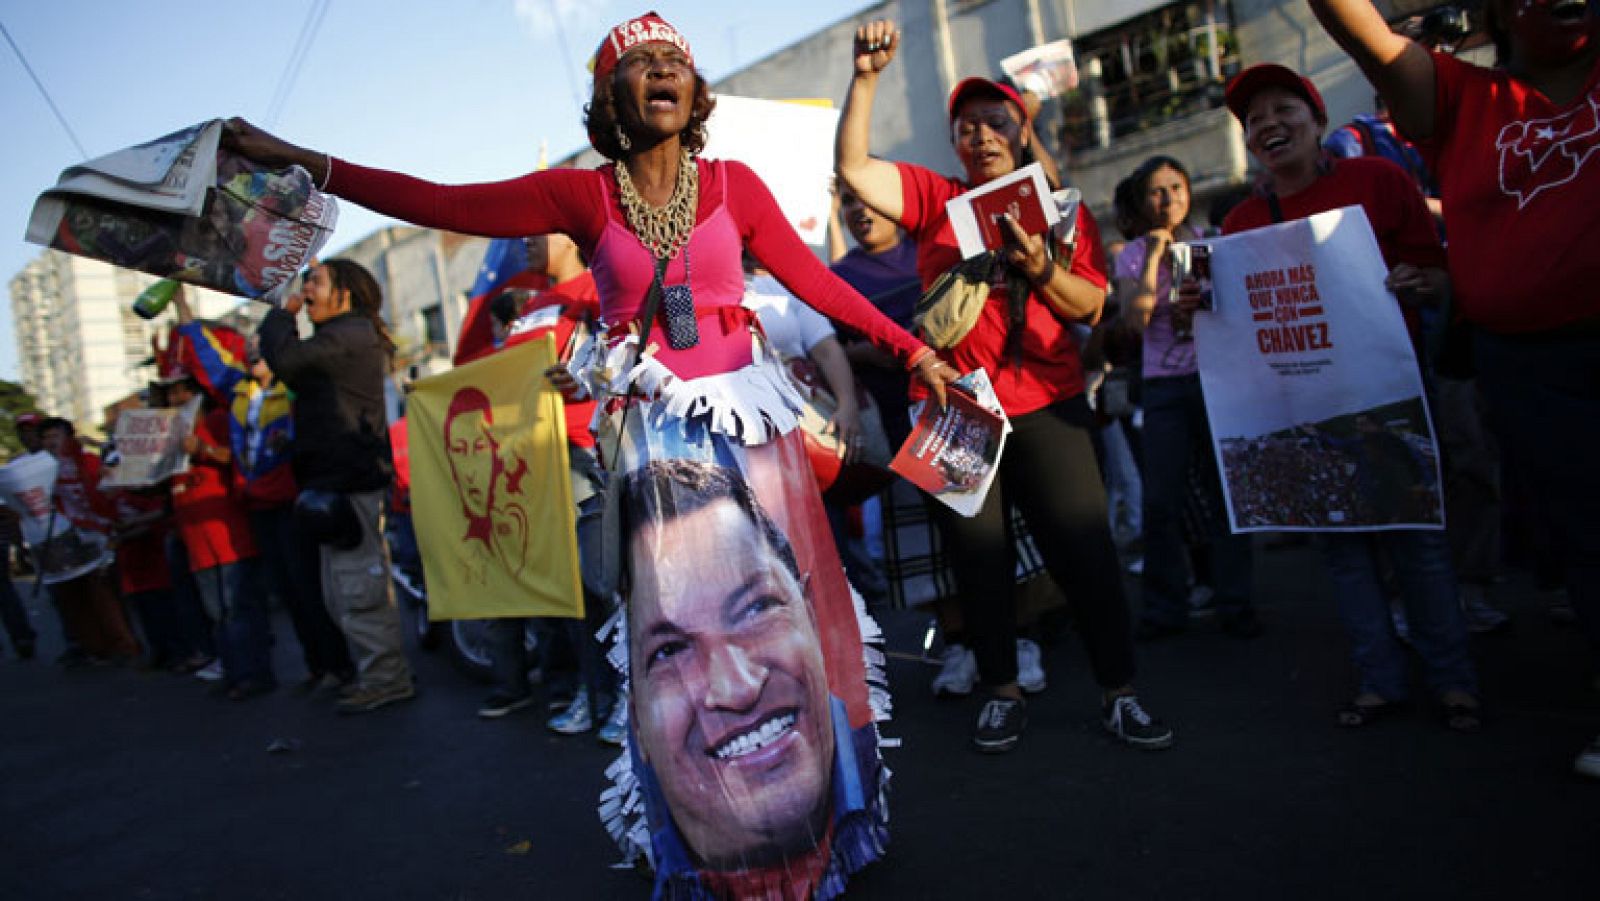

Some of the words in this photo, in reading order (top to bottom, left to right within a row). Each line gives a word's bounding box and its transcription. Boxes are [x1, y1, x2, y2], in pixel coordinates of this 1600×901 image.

[1245, 270, 1285, 290] AHORA
[1288, 263, 1315, 284] MÁS
[1249, 291, 1273, 309] QUE
[1275, 284, 1320, 304] NUNCA
[1275, 306, 1299, 323] CON
[1257, 322, 1333, 354] CHÁVEZ
